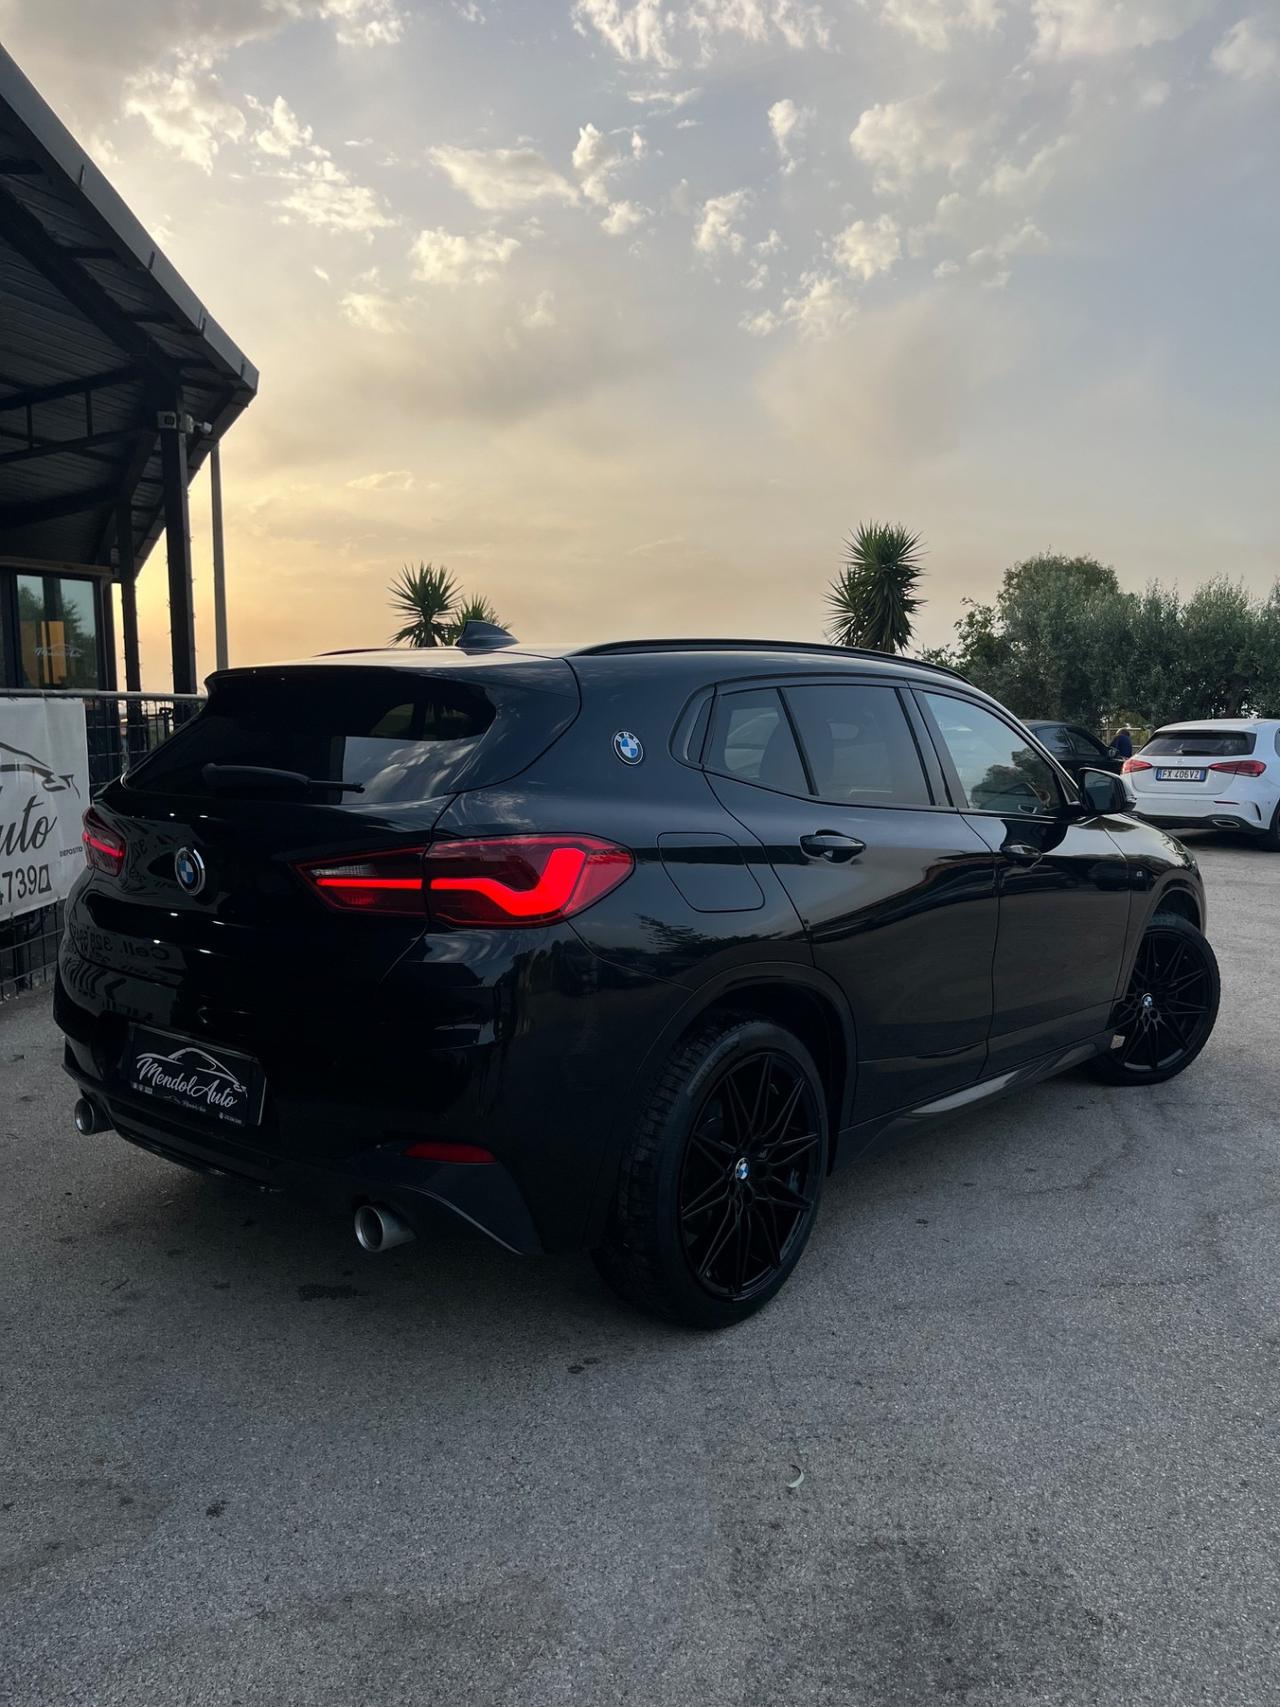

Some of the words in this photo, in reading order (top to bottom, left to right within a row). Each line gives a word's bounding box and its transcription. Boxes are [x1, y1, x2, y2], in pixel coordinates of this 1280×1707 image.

[1161, 769, 1172, 779] FX
[0, 786, 58, 857] uto
[136, 1057, 238, 1108] MendolAuto
